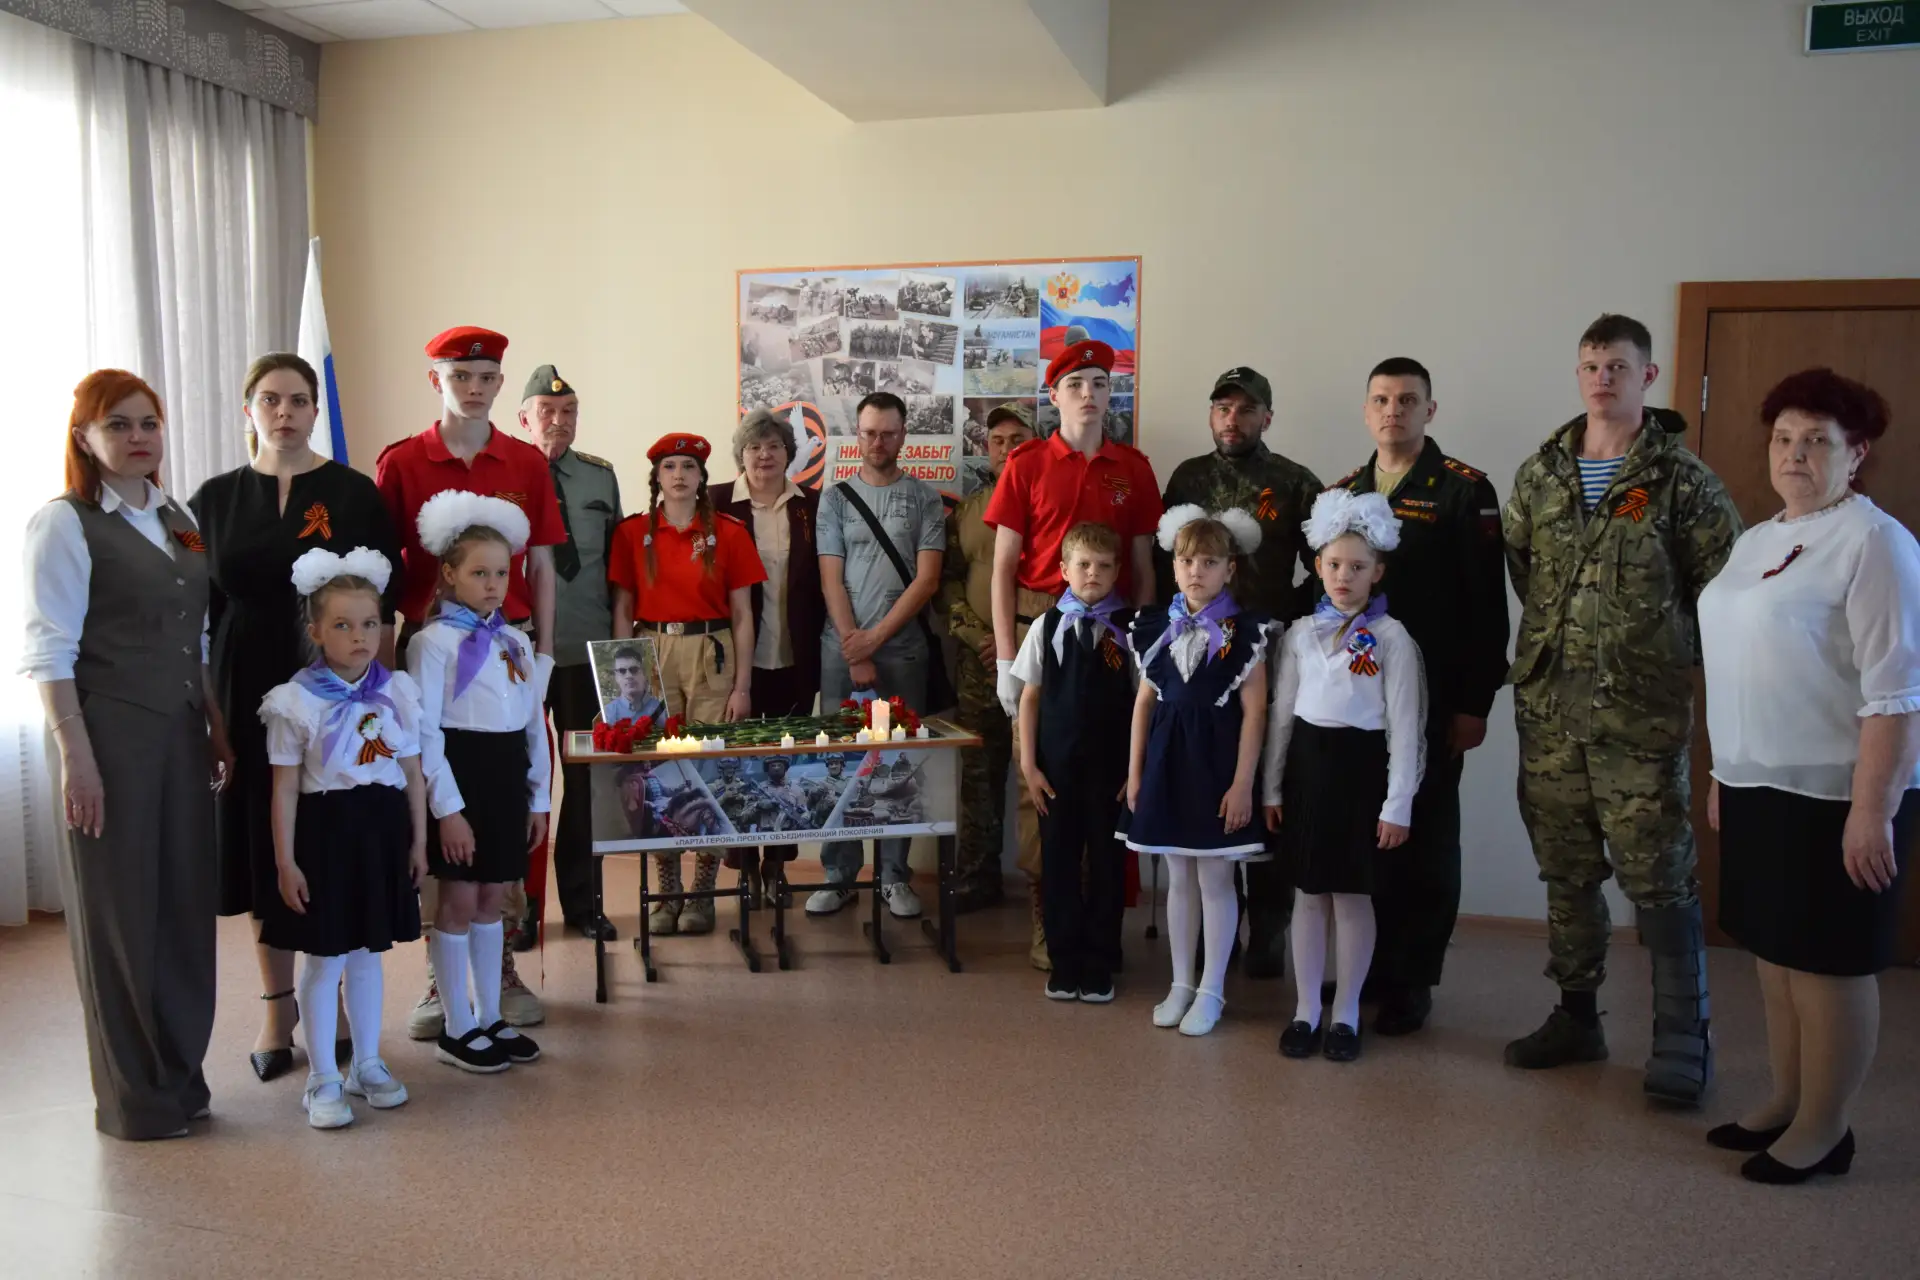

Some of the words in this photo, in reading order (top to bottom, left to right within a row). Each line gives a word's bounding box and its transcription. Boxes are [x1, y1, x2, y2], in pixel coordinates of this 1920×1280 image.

[1843, 5, 1904, 26] ВЫХОД
[1856, 28, 1892, 42] EXIT
[905, 445, 952, 459] ЗАБЫТ
[769, 830, 837, 840] ОБЪЕДИНЯЮЩИЙ
[839, 828, 884, 837] ПОКОЛЕНИЯ
